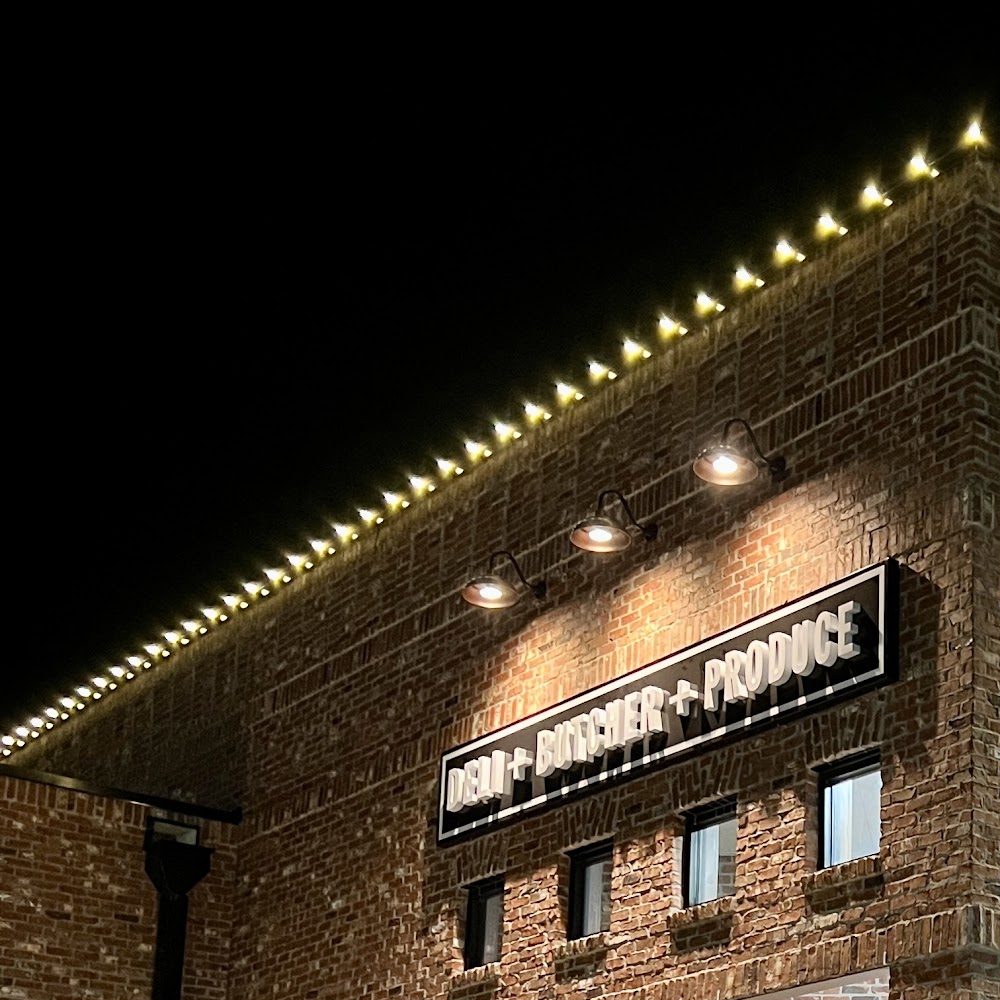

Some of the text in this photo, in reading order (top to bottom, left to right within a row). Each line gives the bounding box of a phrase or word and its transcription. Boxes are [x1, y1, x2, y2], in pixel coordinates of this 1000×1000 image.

[446, 750, 511, 812] DELI
[536, 685, 669, 777] BUTCHER
[704, 601, 861, 712] PRODUCE
